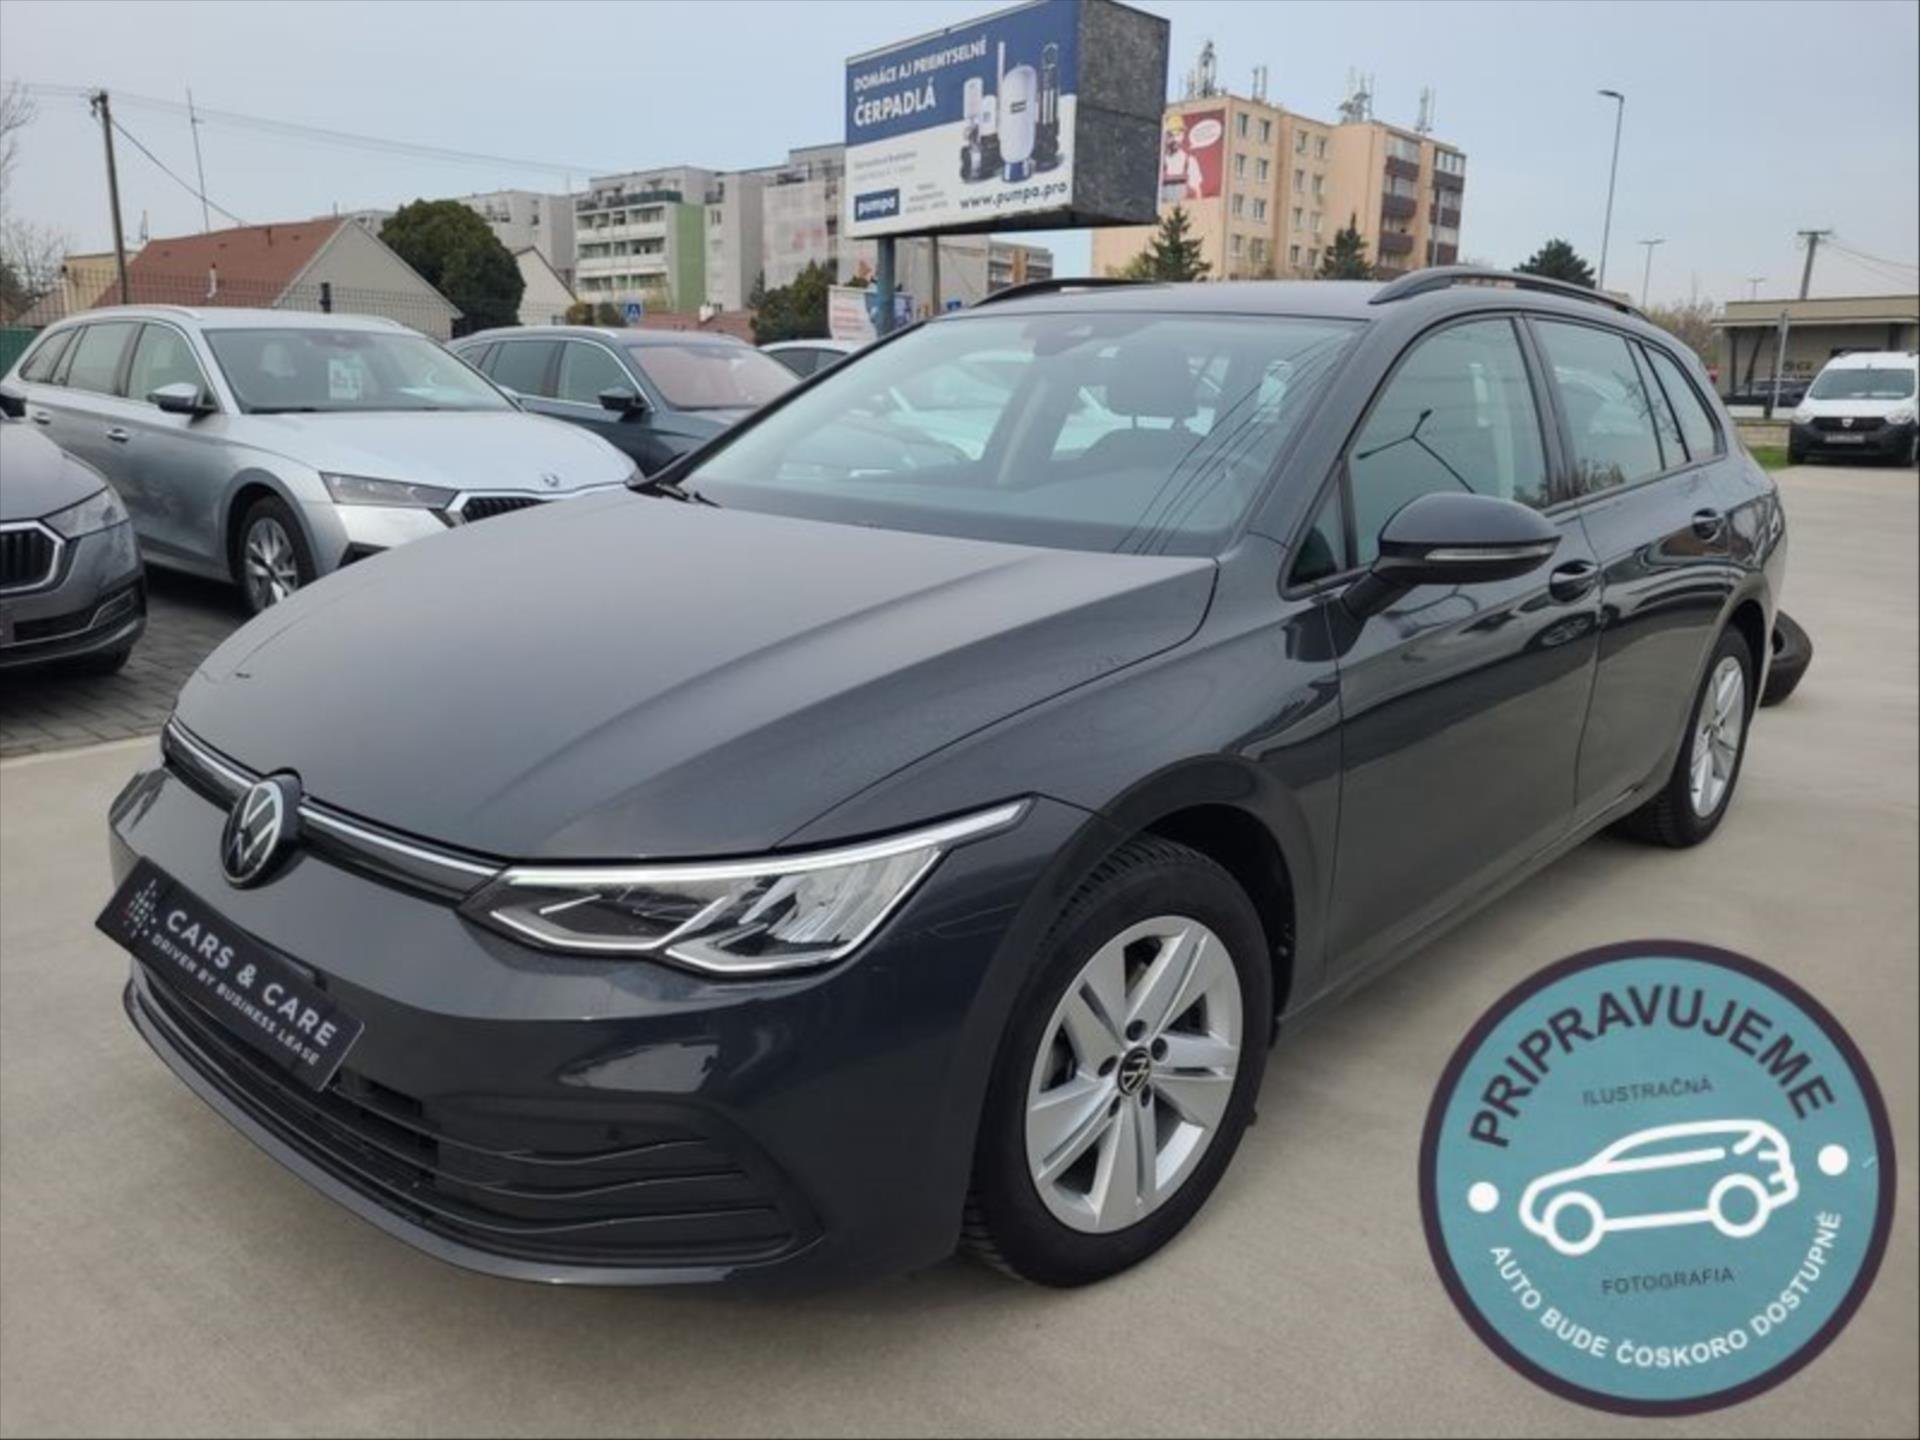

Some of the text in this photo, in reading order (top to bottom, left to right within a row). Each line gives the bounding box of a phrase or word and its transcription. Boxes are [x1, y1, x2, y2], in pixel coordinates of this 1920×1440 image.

[854, 66, 897, 93] DOMÁCE
[899, 60, 912, 80] AJ
[854, 77, 936, 126] ČERPADLÁ
[151, 933, 320, 1066] DRIVER BY BUSINESS LEASE
[167, 909, 337, 1047] CARS & CARE
